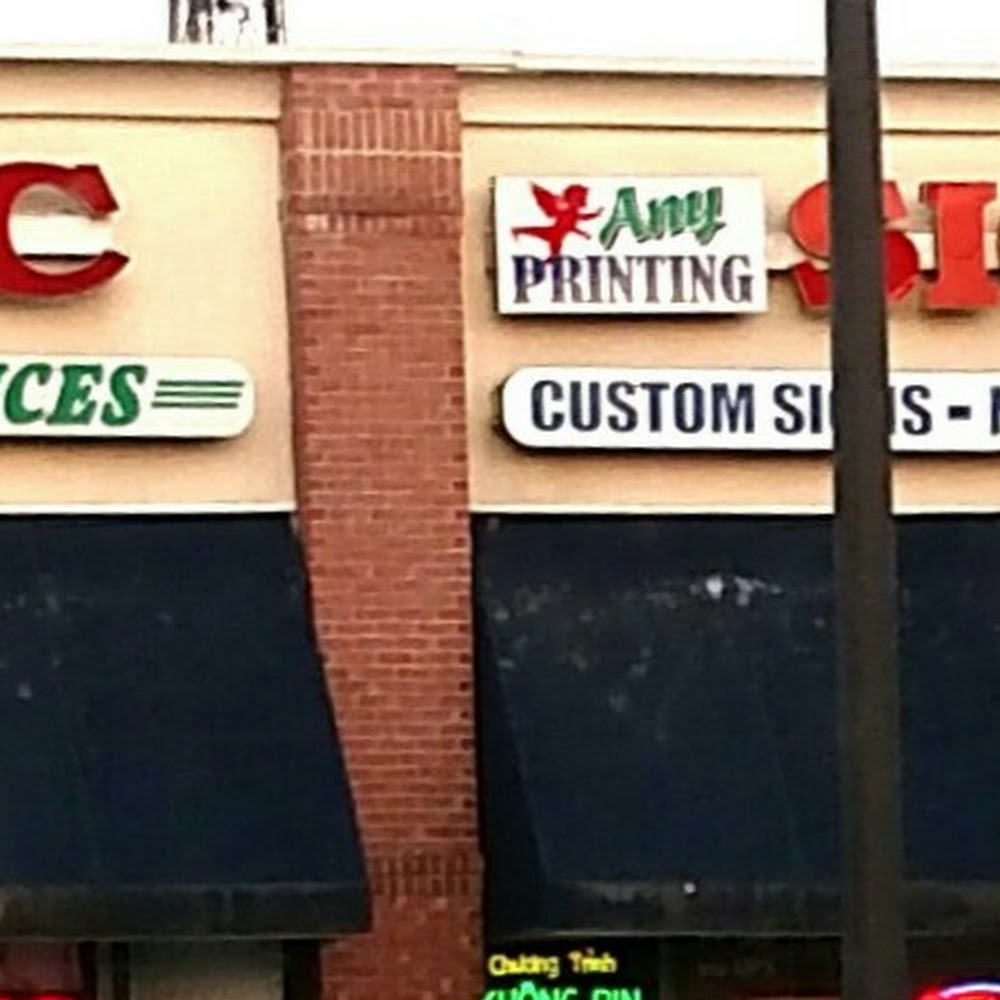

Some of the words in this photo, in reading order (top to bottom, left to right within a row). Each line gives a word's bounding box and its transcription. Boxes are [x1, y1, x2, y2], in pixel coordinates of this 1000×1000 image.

[599, 185, 727, 250] Any
[511, 254, 754, 305] PRINTING
[0, 362, 147, 427] CES
[530, 379, 755, 434] CUSTOM
[773, 382, 933, 436] SIS
